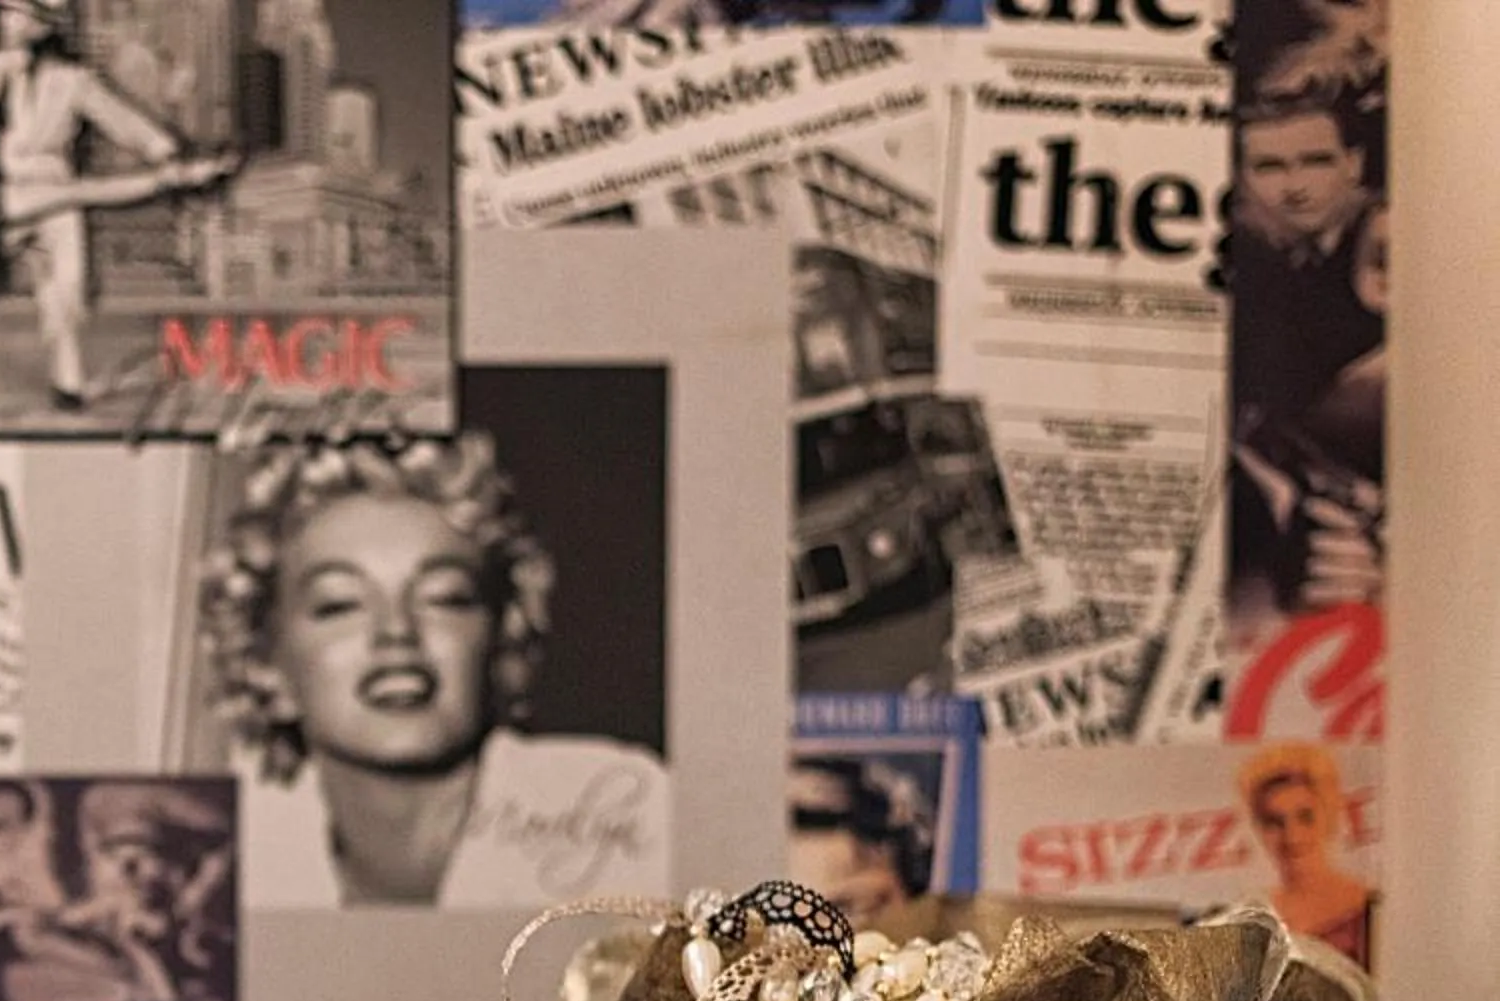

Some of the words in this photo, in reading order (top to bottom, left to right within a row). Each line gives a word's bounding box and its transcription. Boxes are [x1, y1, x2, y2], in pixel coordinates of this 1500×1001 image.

[488, 107, 634, 173] Maine
[636, 56, 799, 131] lobster
[161, 317, 415, 393] MAGIC
